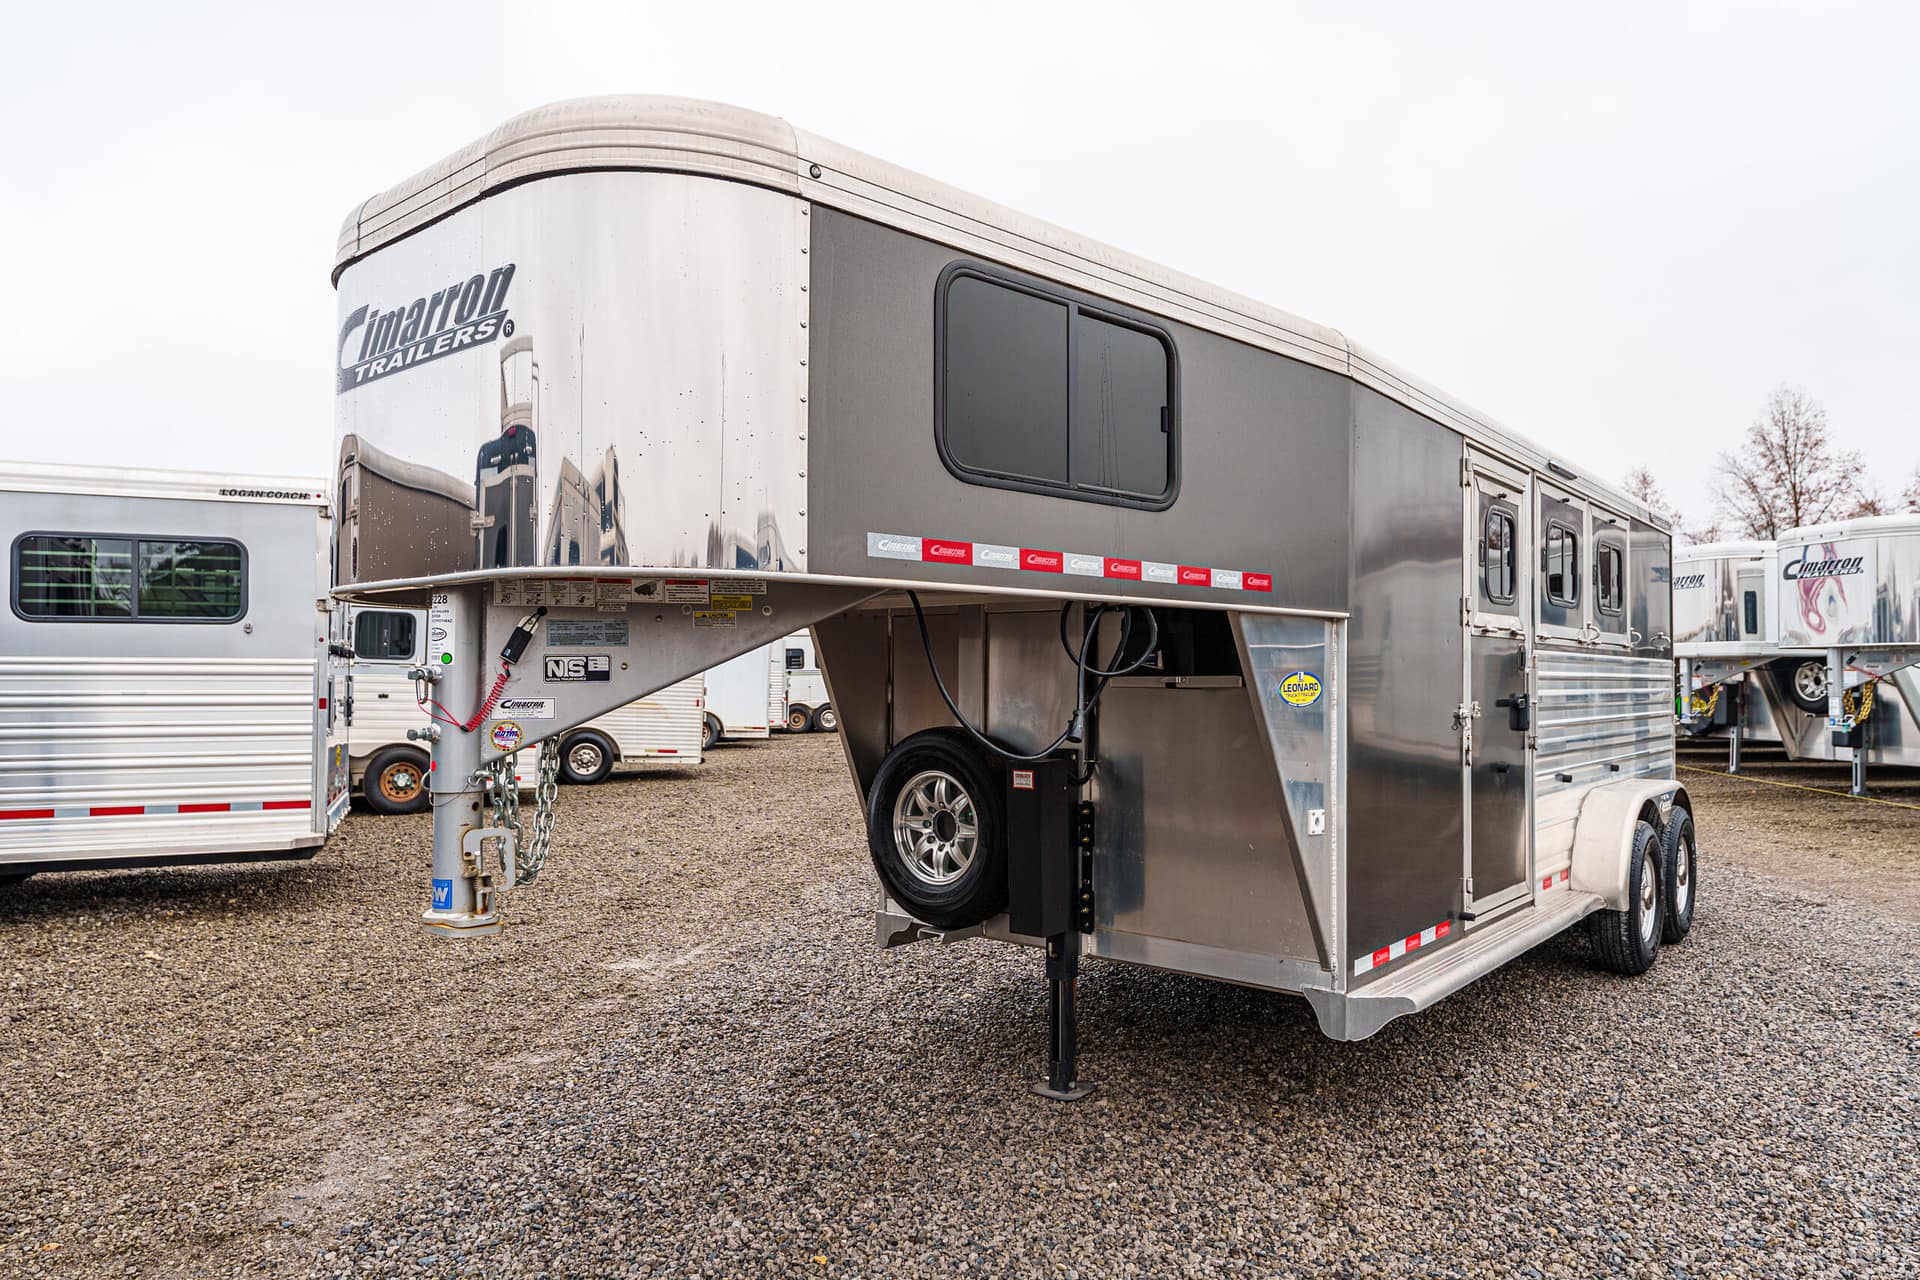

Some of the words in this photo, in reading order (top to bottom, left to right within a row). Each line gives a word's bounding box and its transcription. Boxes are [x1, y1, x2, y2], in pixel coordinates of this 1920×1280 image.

[337, 263, 516, 388] Cimarron
[355, 318, 497, 383] TRAILERS
[219, 488, 264, 498] LOGAN
[266, 490, 311, 500] COACH
[1783, 556, 1864, 580] Cimarron
[1672, 574, 1705, 585] arron
[1283, 682, 1319, 692] LEONARD
